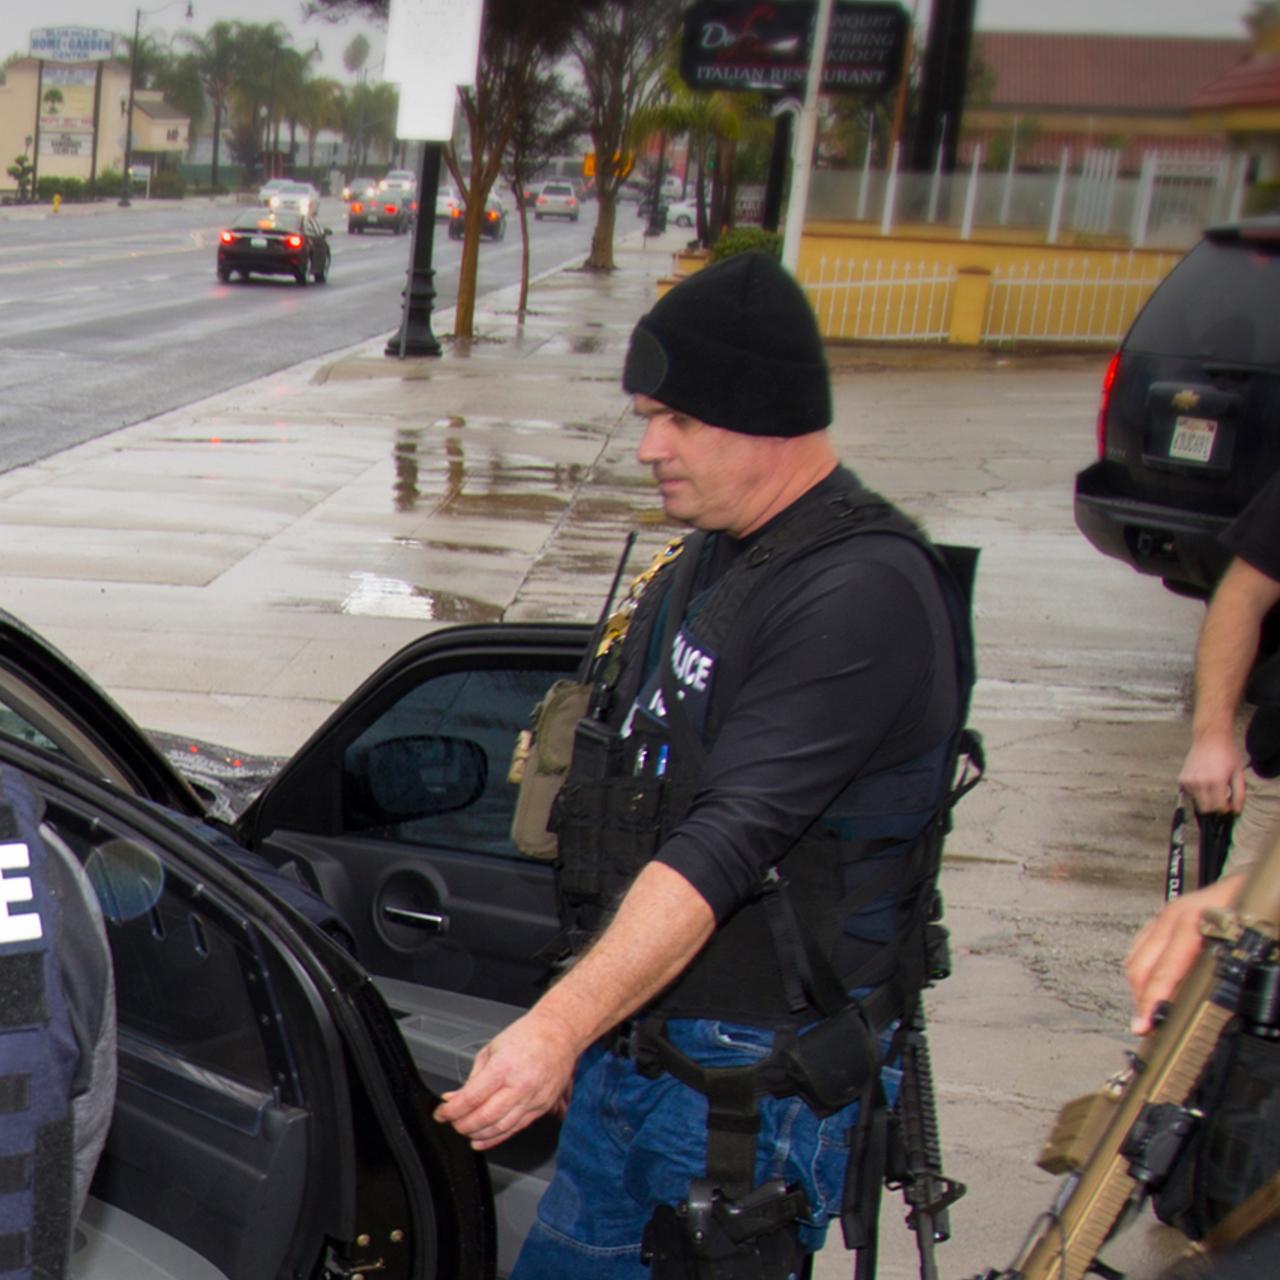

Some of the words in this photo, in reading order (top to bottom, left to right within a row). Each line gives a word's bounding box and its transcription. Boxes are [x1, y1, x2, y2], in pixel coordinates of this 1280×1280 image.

[31, 38, 61, 50] HOME
[69, 38, 111, 51] GARDEN
[807, 31, 894, 47] TERING
[696, 66, 764, 81] ITALIAN
[770, 67, 887, 84] RESURANT
[671, 630, 713, 692] LICE
